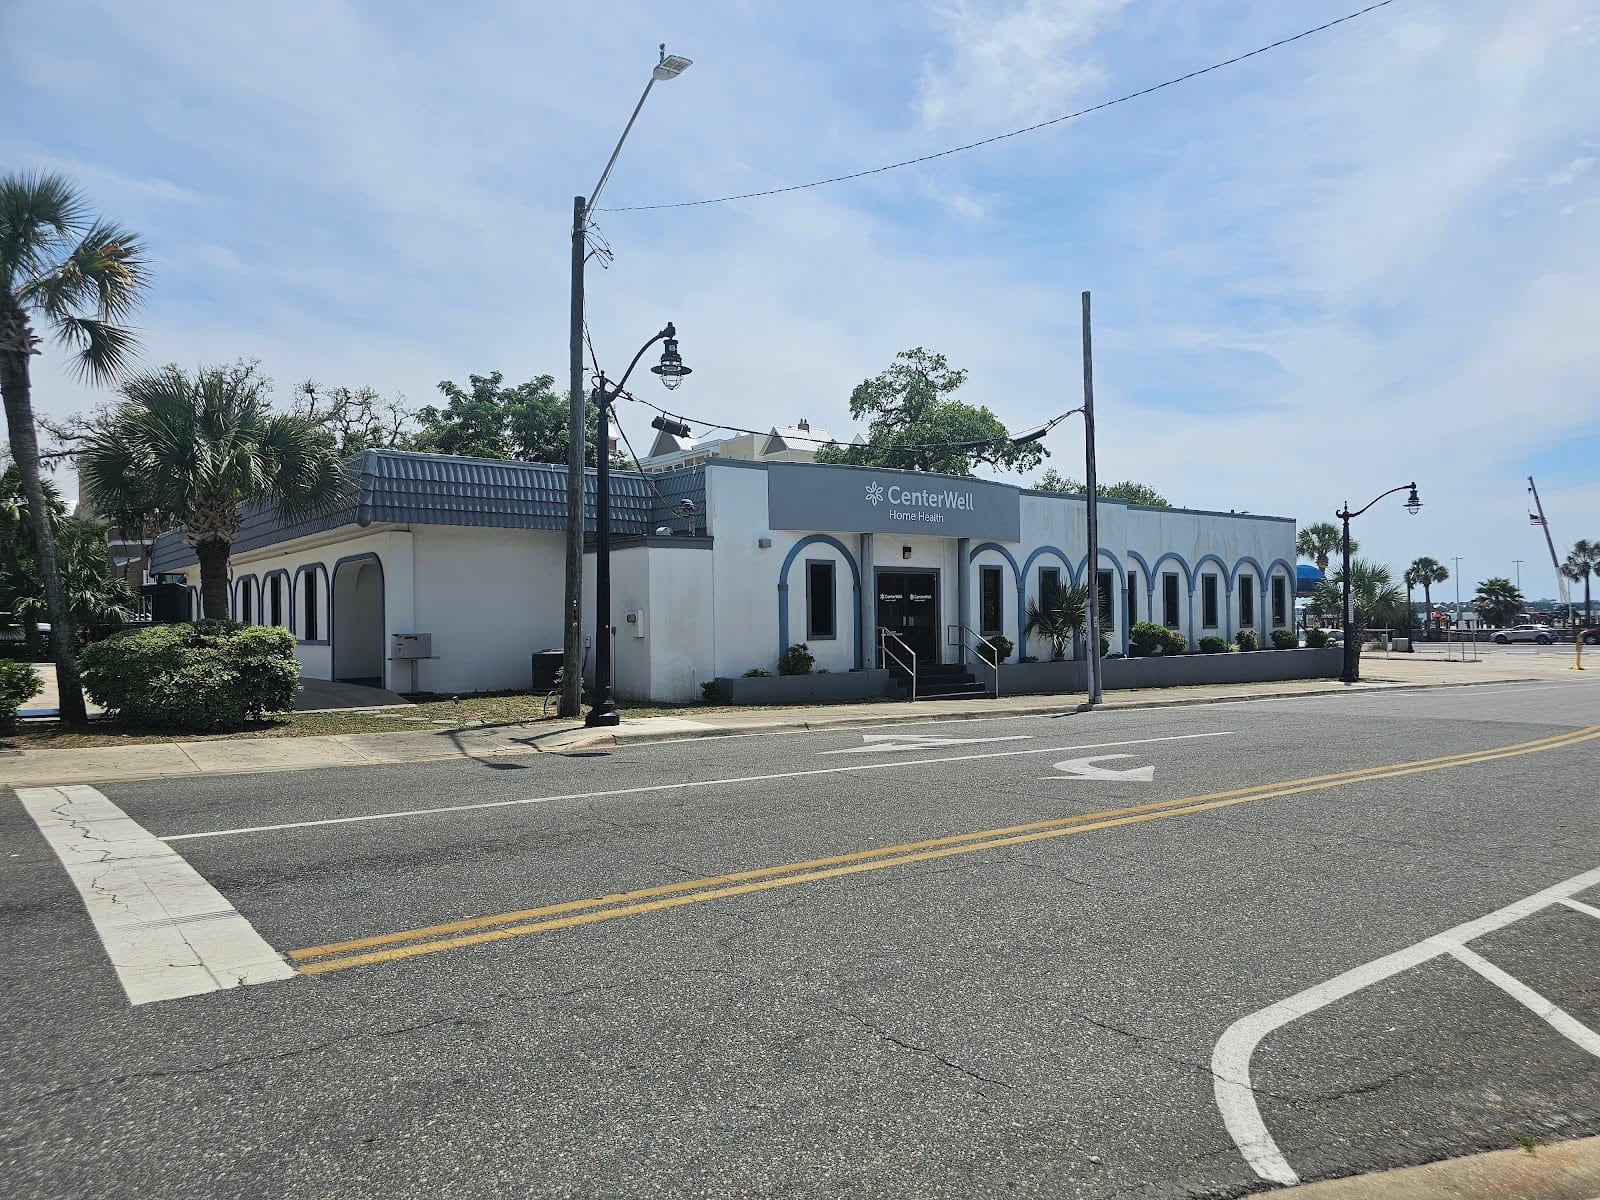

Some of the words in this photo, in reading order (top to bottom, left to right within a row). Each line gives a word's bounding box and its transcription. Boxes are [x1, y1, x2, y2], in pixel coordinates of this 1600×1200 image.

[887, 485, 974, 511] CenterWell
[889, 509, 916, 521] Home
[918, 511, 944, 523] Health
